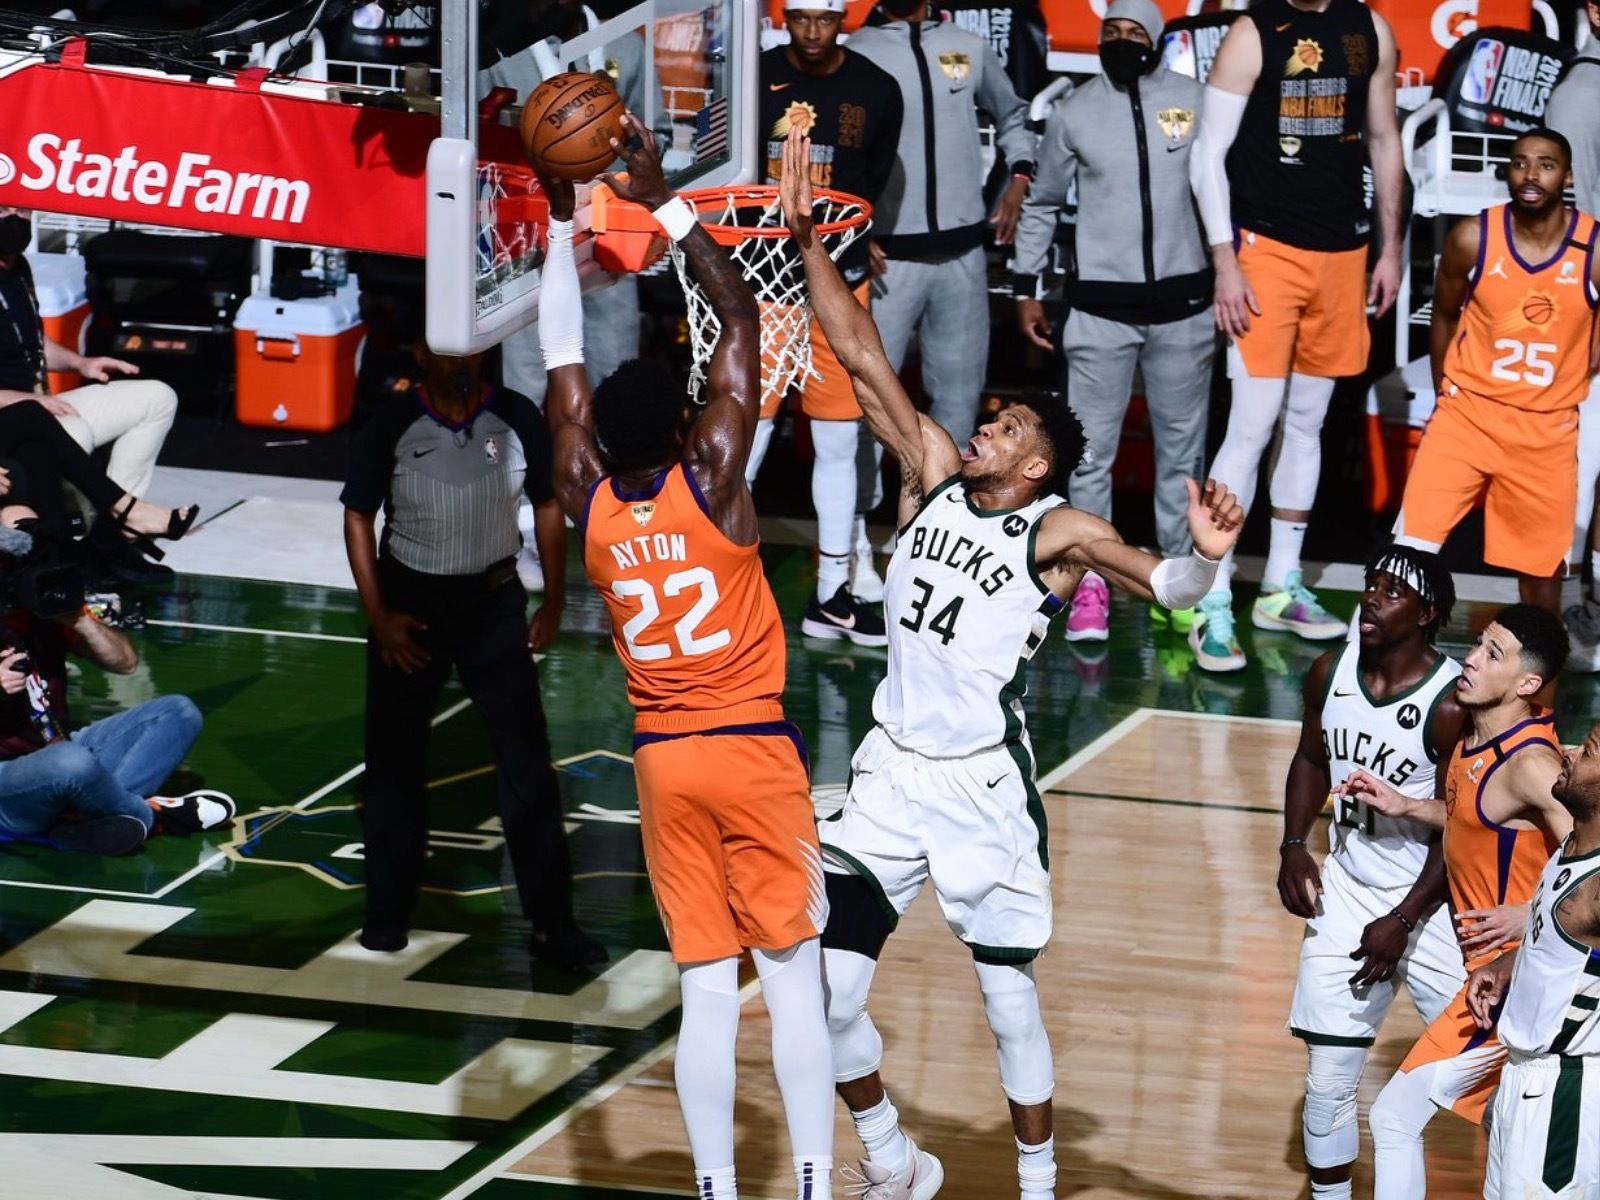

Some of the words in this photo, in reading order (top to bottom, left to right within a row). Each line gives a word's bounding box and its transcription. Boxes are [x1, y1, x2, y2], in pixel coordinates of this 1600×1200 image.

[954, 8, 990, 40] NBA
[991, 7, 1012, 39] 2021
[1501, 45, 1541, 83] NBA
[1534, 55, 1563, 88] 2021
[1280, 96, 1306, 117] NBA
[1307, 95, 1346, 117] FINALS
[1491, 76, 1552, 118] FINALS
[1491, 337, 1558, 388] 25
[609, 532, 687, 571] AYTON
[910, 526, 1015, 598] BUCKS
[611, 566, 732, 661] 22
[899, 576, 965, 647] 34
